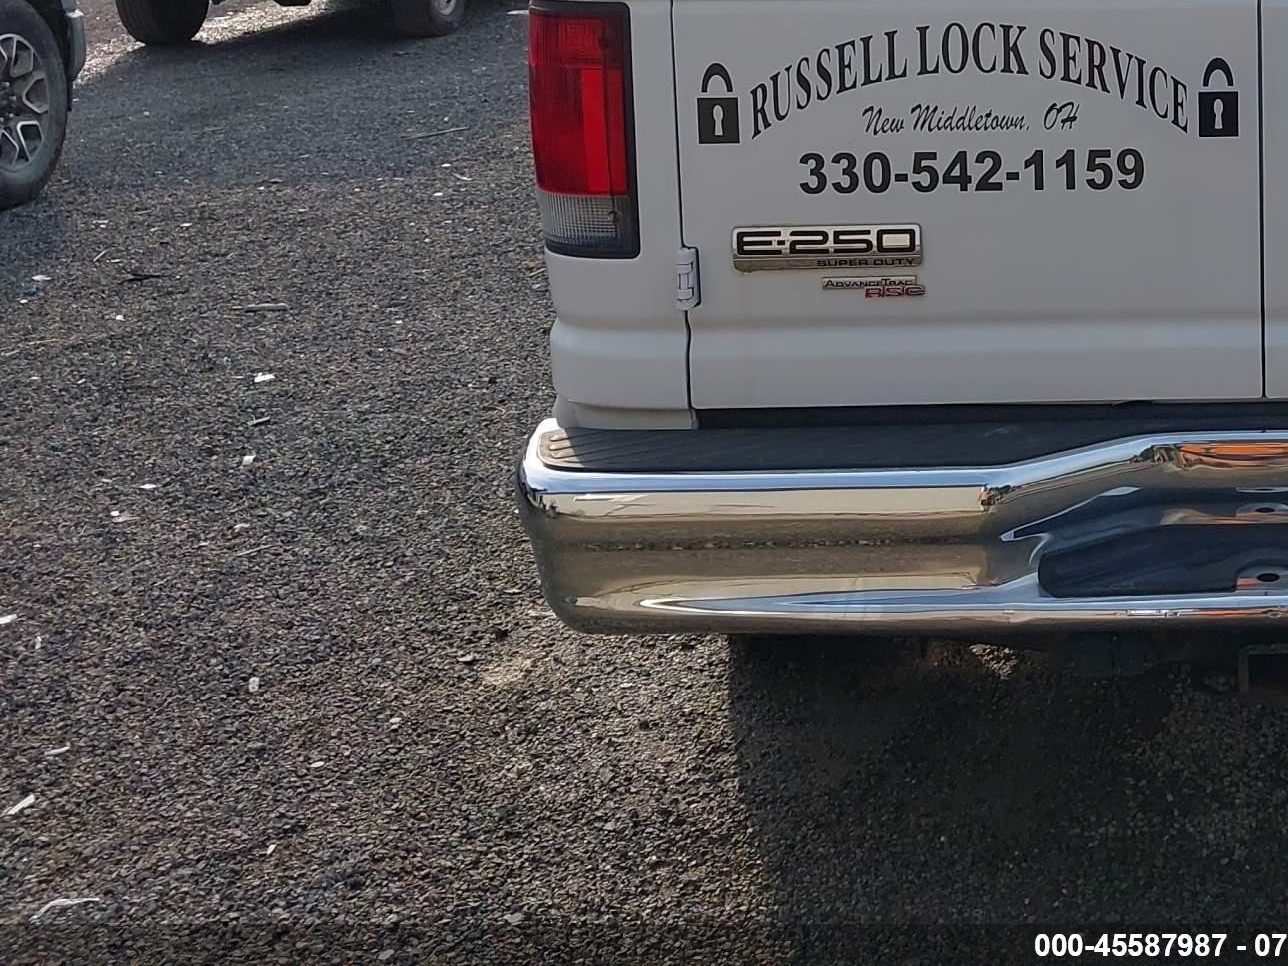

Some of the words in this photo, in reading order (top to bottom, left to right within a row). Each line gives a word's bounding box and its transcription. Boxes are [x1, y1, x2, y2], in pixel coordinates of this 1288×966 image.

[750, 30, 907, 140] RUSSELL
[915, 22, 1029, 76] LOCK
[1039, 28, 1188, 134] SERVICE
[862, 105, 905, 135] New
[1044, 101, 1080, 131] OH
[799, 148, 1145, 195] 330-542-1159
[736, 228, 916, 256] E-250
[816, 258, 869, 267] SUPER
[872, 258, 915, 266] DUTY
